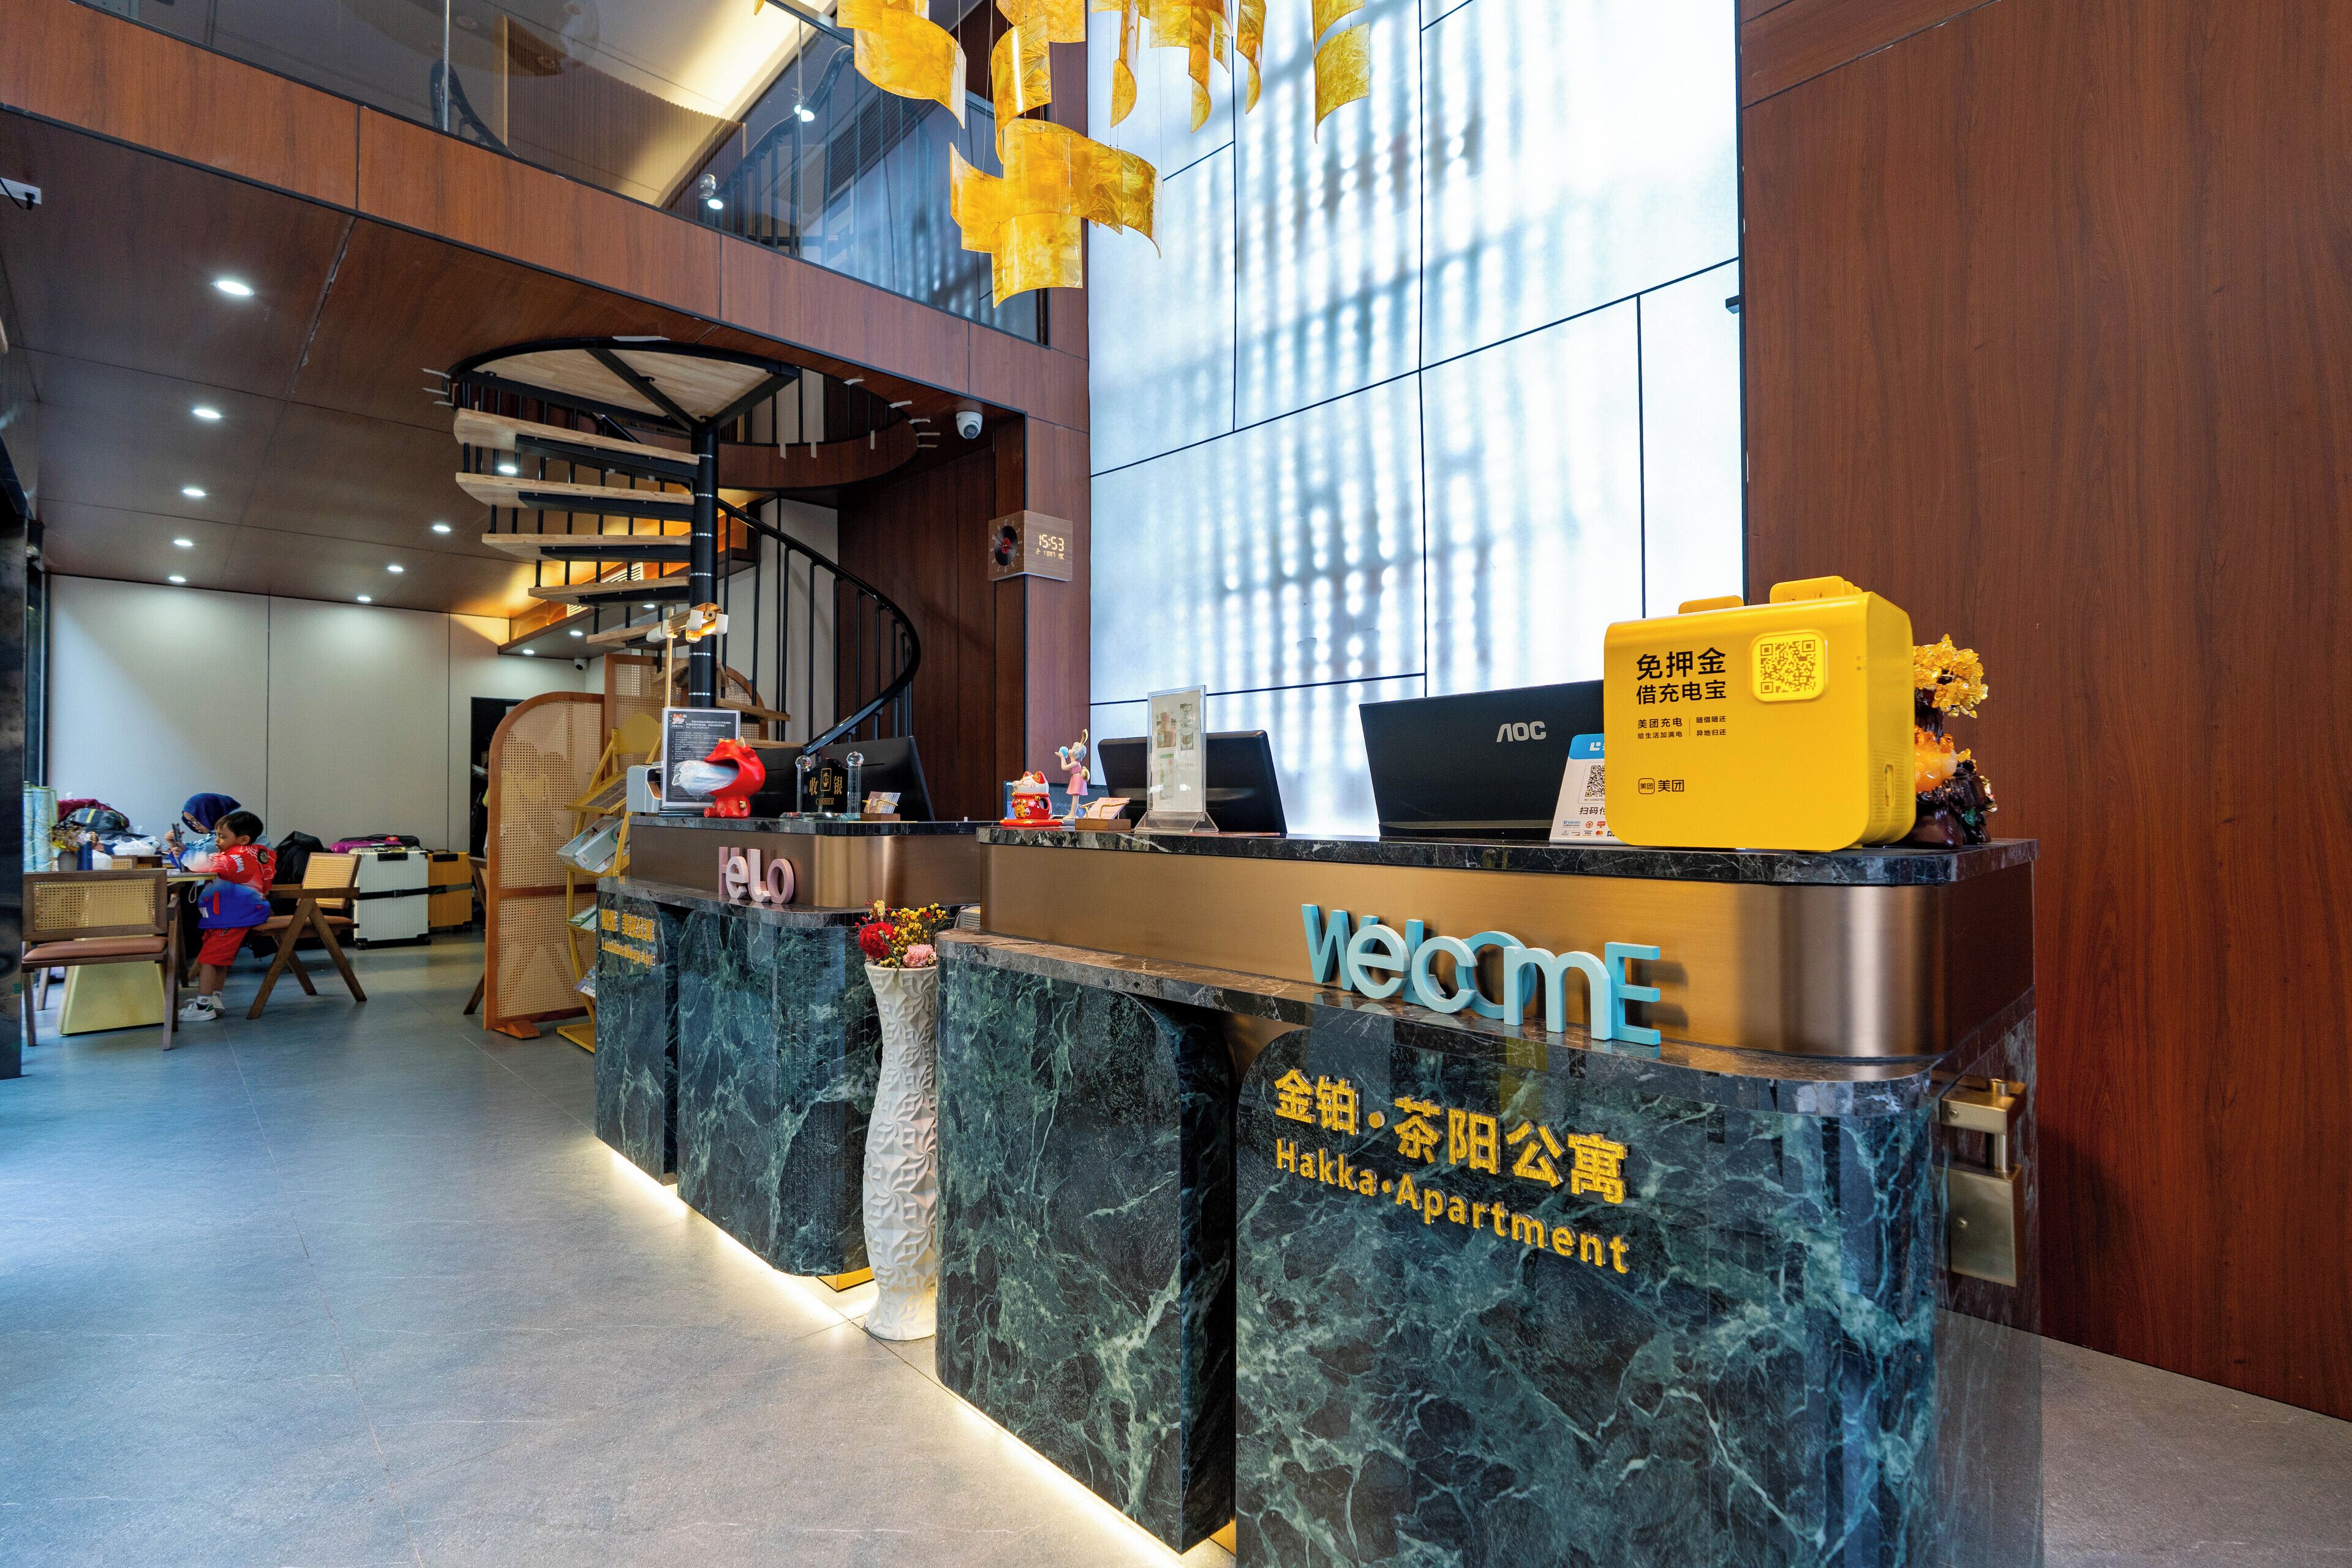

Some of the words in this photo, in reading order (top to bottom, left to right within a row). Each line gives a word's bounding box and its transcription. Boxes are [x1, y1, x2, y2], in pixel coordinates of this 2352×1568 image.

[1039, 534, 1065, 551] 15:53
[1637, 647, 1726, 681] 免押金
[1637, 680, 1727, 705] 借充电宝
[1496, 721, 1547, 742] AOC
[1638, 717, 1683, 729] 美团充电
[1658, 780, 1684, 792] 美团
